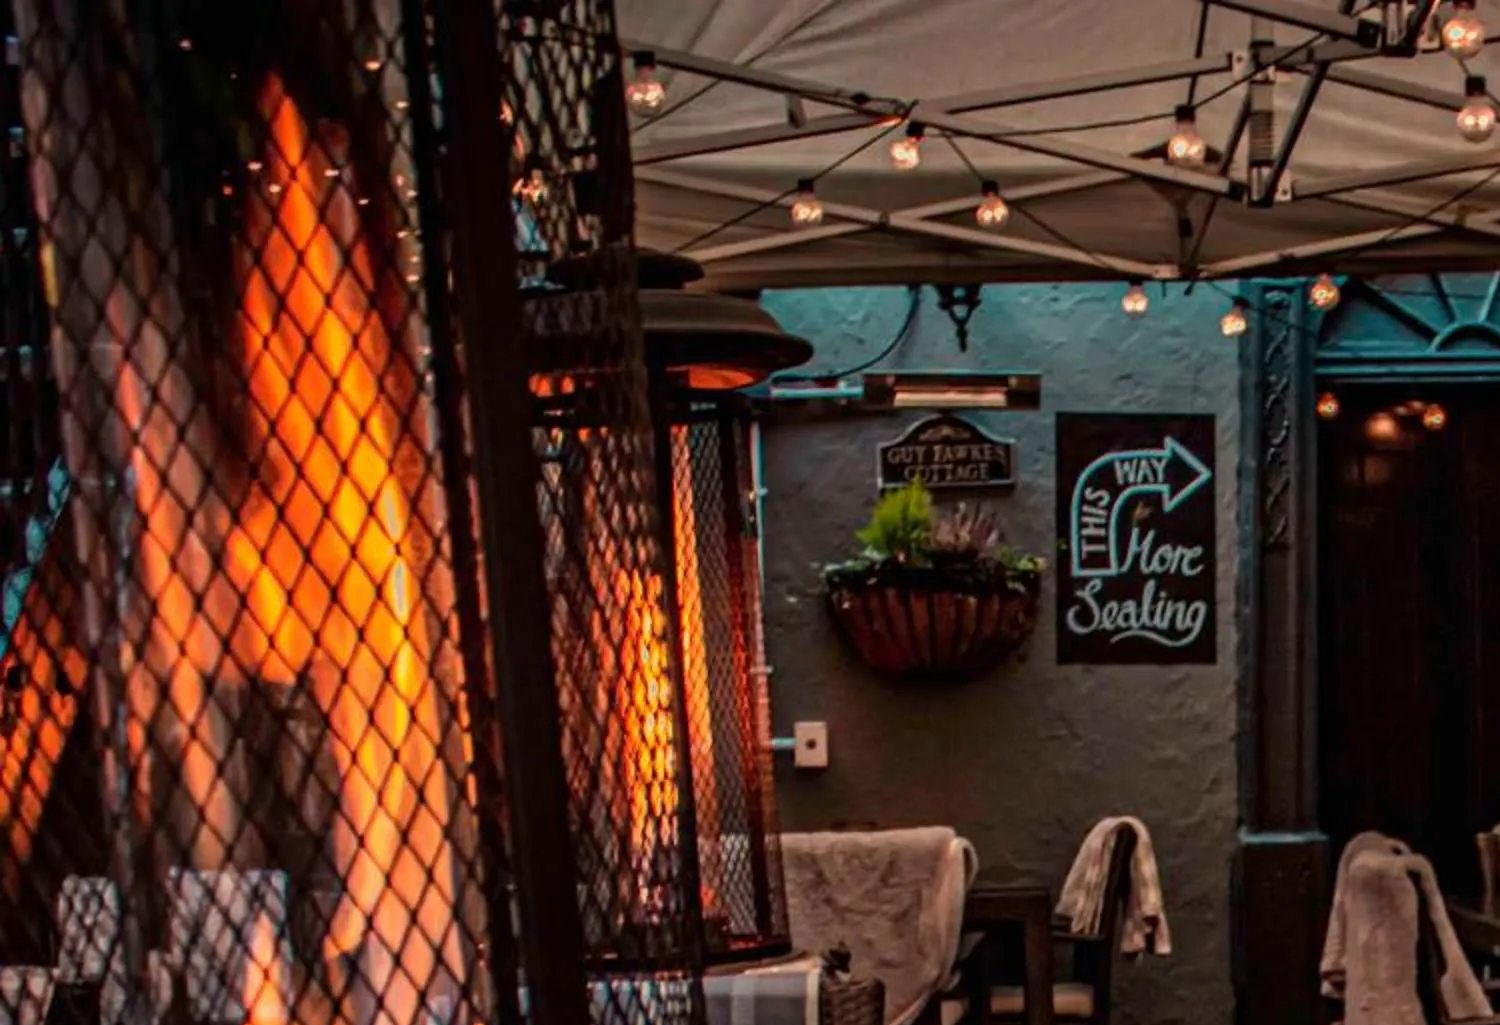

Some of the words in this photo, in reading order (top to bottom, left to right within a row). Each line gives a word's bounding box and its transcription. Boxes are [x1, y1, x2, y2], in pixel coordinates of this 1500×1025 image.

[887, 445, 927, 464] GUY
[904, 462, 989, 481] COTTAGE
[1081, 486, 1111, 560] THIS
[1113, 458, 1168, 484] WAY
[1120, 526, 1205, 577] More
